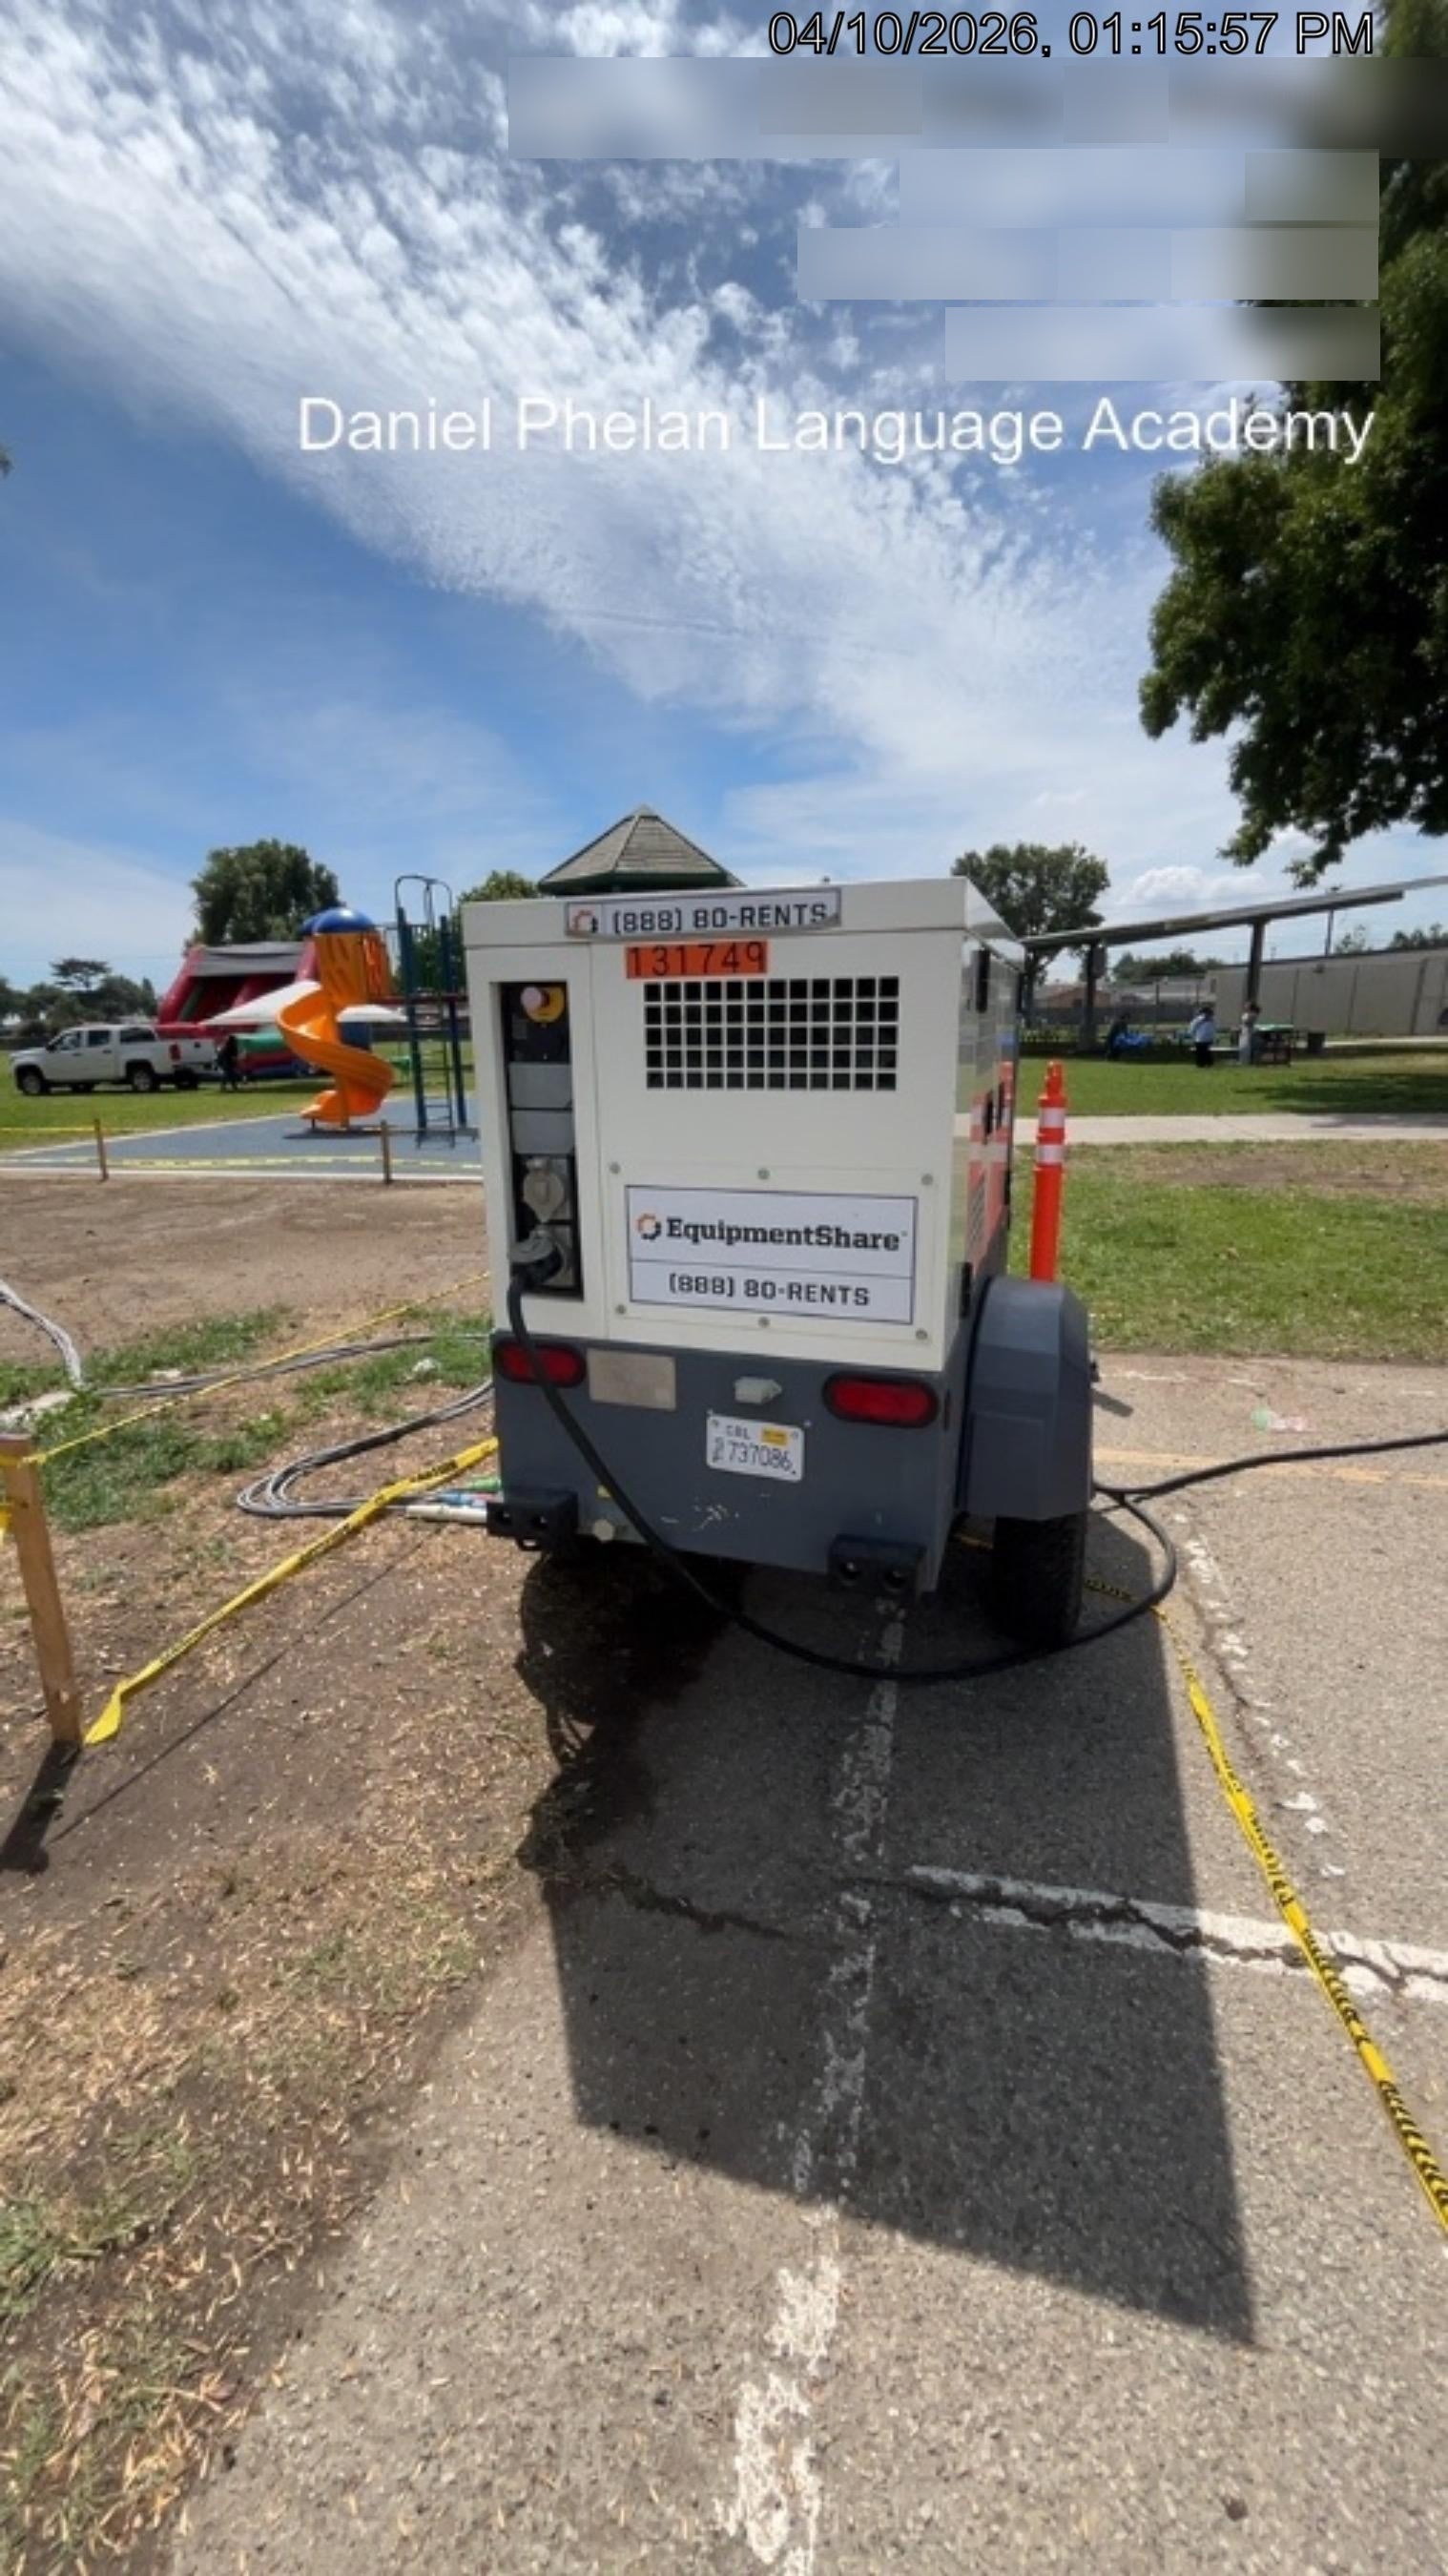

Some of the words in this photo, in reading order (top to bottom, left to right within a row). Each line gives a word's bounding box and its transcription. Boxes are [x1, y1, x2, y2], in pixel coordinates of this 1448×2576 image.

[612, 907, 682, 934] (888)
[693, 902, 828, 928] 80-RENTS
[630, 941, 764, 976] 131749
[666, 1217, 900, 1251] EquipmentShare
[669, 1273, 734, 1298] (888)
[744, 1278, 869, 1307] 80-RENTS
